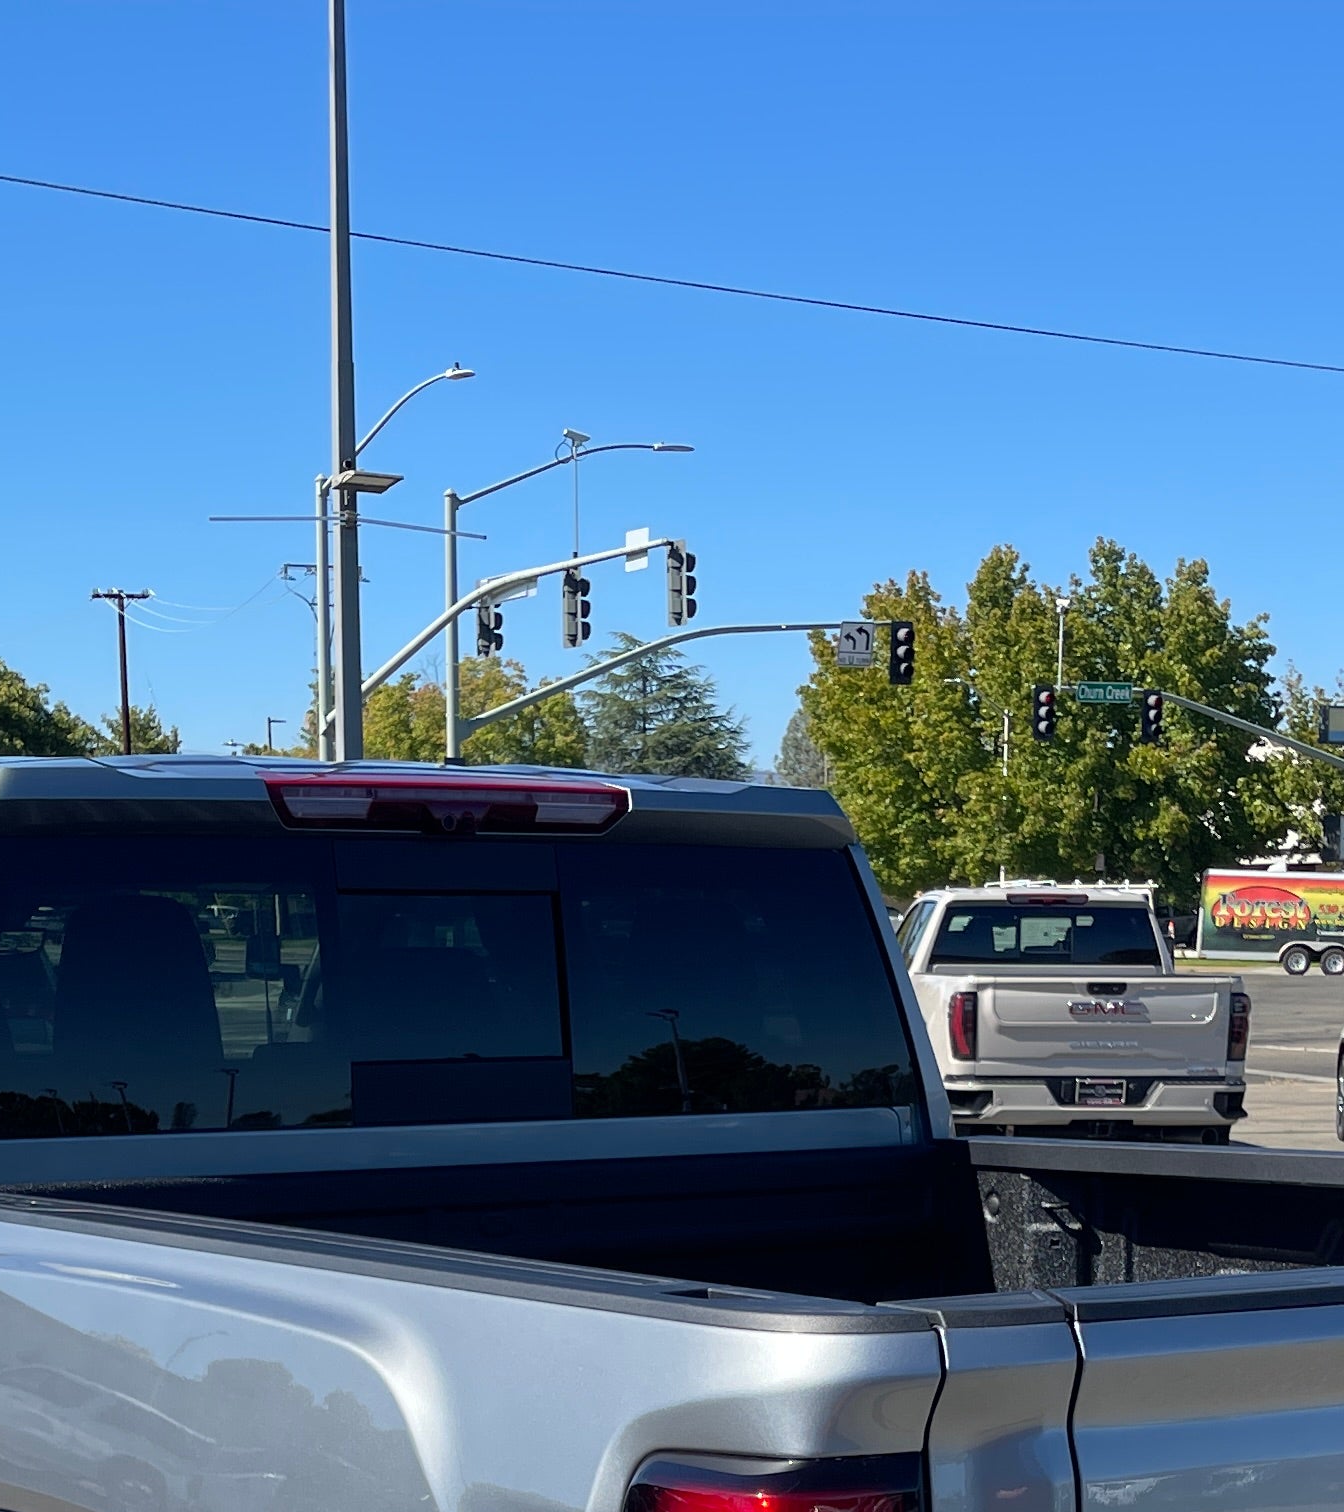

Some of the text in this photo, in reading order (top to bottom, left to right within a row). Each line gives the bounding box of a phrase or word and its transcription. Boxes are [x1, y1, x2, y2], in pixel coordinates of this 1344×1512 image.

[1078, 684, 1130, 700] Churn Creek
[1217, 892, 1307, 918] Forest
[1215, 915, 1306, 930] DESIGN
